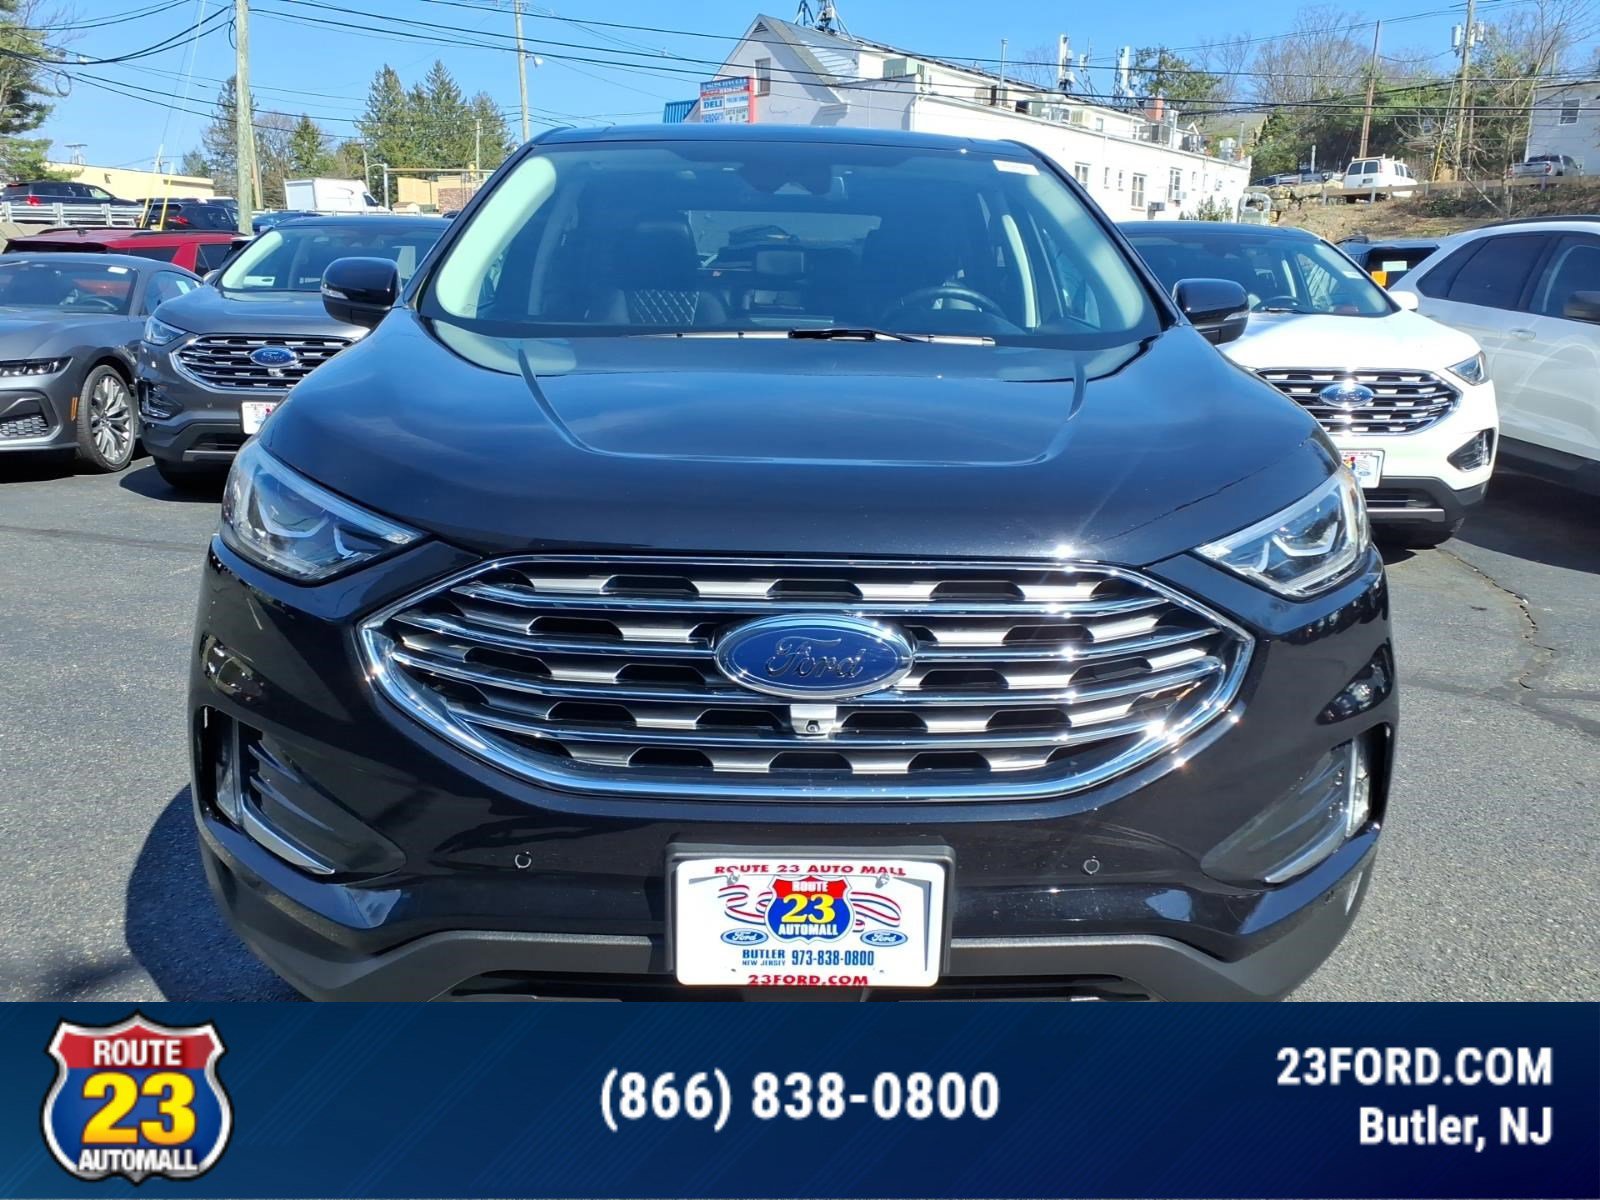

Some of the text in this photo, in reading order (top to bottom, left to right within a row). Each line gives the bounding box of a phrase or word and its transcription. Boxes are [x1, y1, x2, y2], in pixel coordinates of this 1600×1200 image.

[704, 100, 722, 108] DELI
[766, 636, 866, 678] Ford
[714, 864, 907, 876] ROUTE 23 AUTO MALL
[791, 881, 828, 893] ROUTE
[781, 893, 835, 923] 23
[778, 923, 838, 937] AUTOMALL
[731, 931, 758, 942] Ford
[870, 932, 897, 943] Ford
[742, 949, 875, 966] BUTLER 973-838-0800
[748, 974, 869, 986] 23FORD.COM
